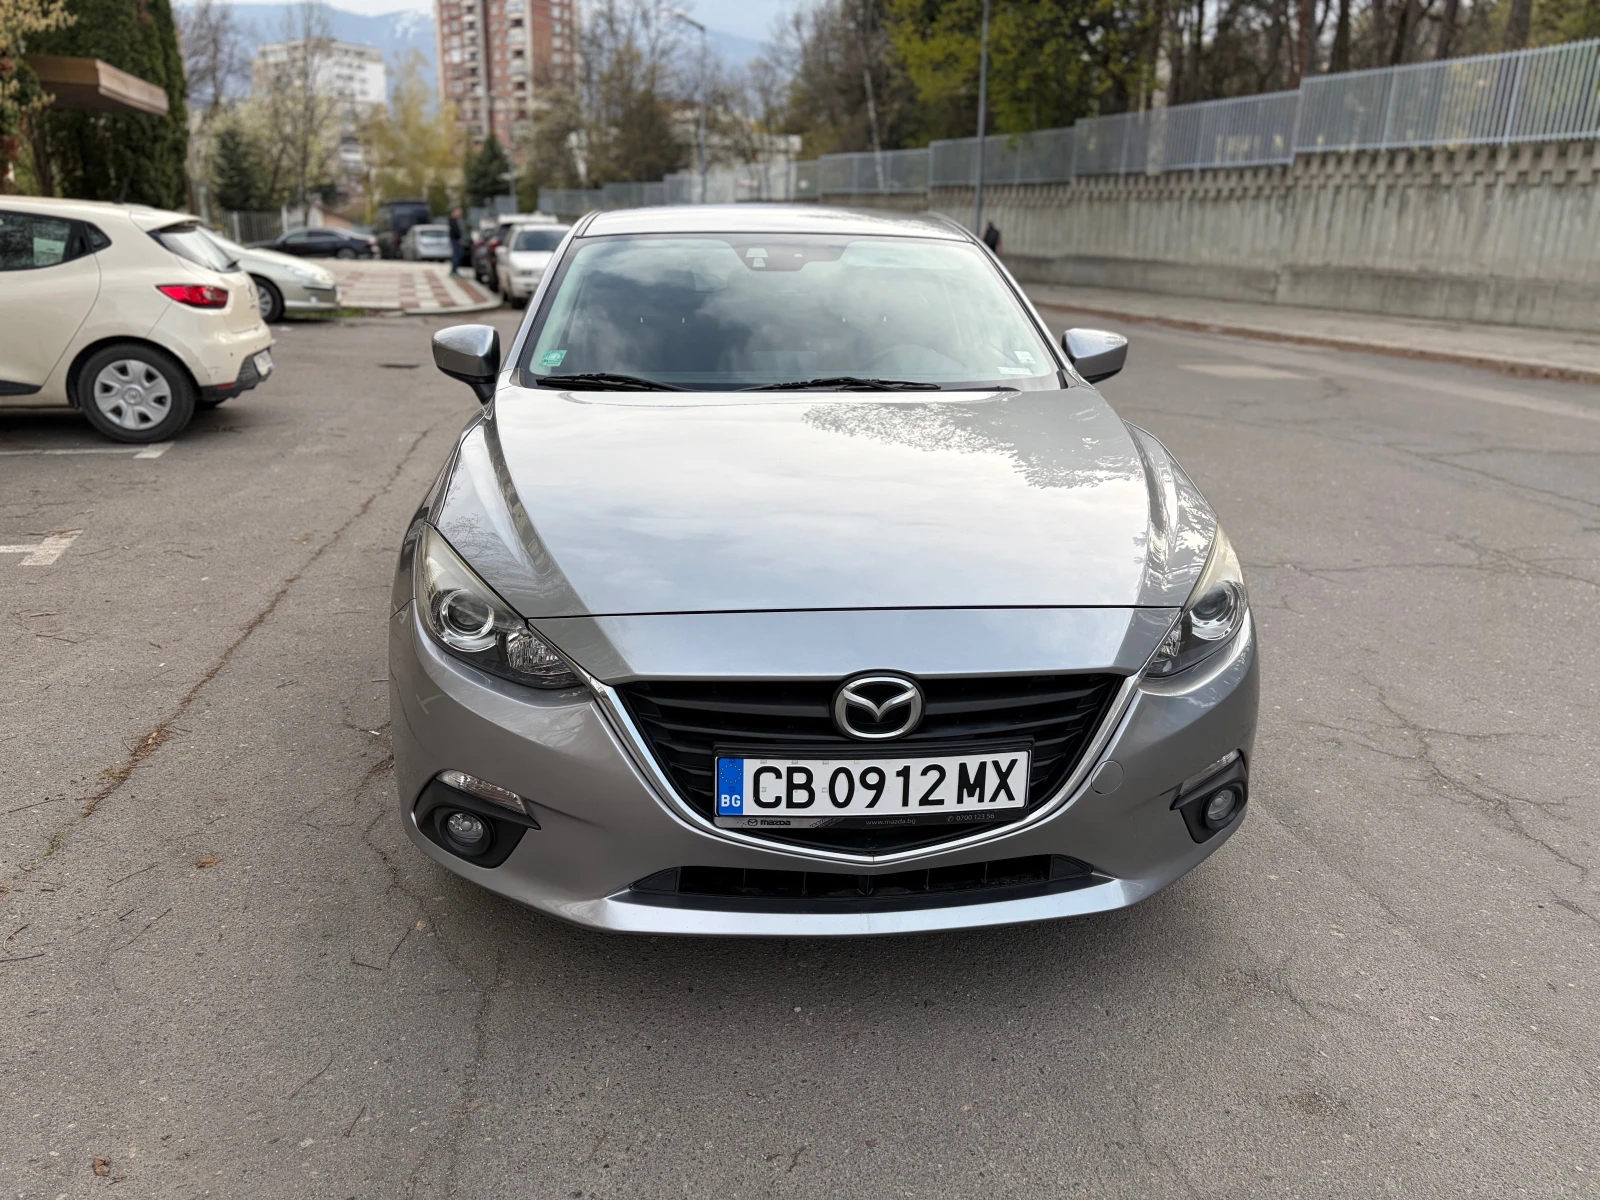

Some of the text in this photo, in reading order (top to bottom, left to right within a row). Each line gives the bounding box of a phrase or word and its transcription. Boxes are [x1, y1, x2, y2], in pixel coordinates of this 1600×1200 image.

[753, 759, 1018, 809] CB 0912 MX
[721, 794, 741, 807] BG
